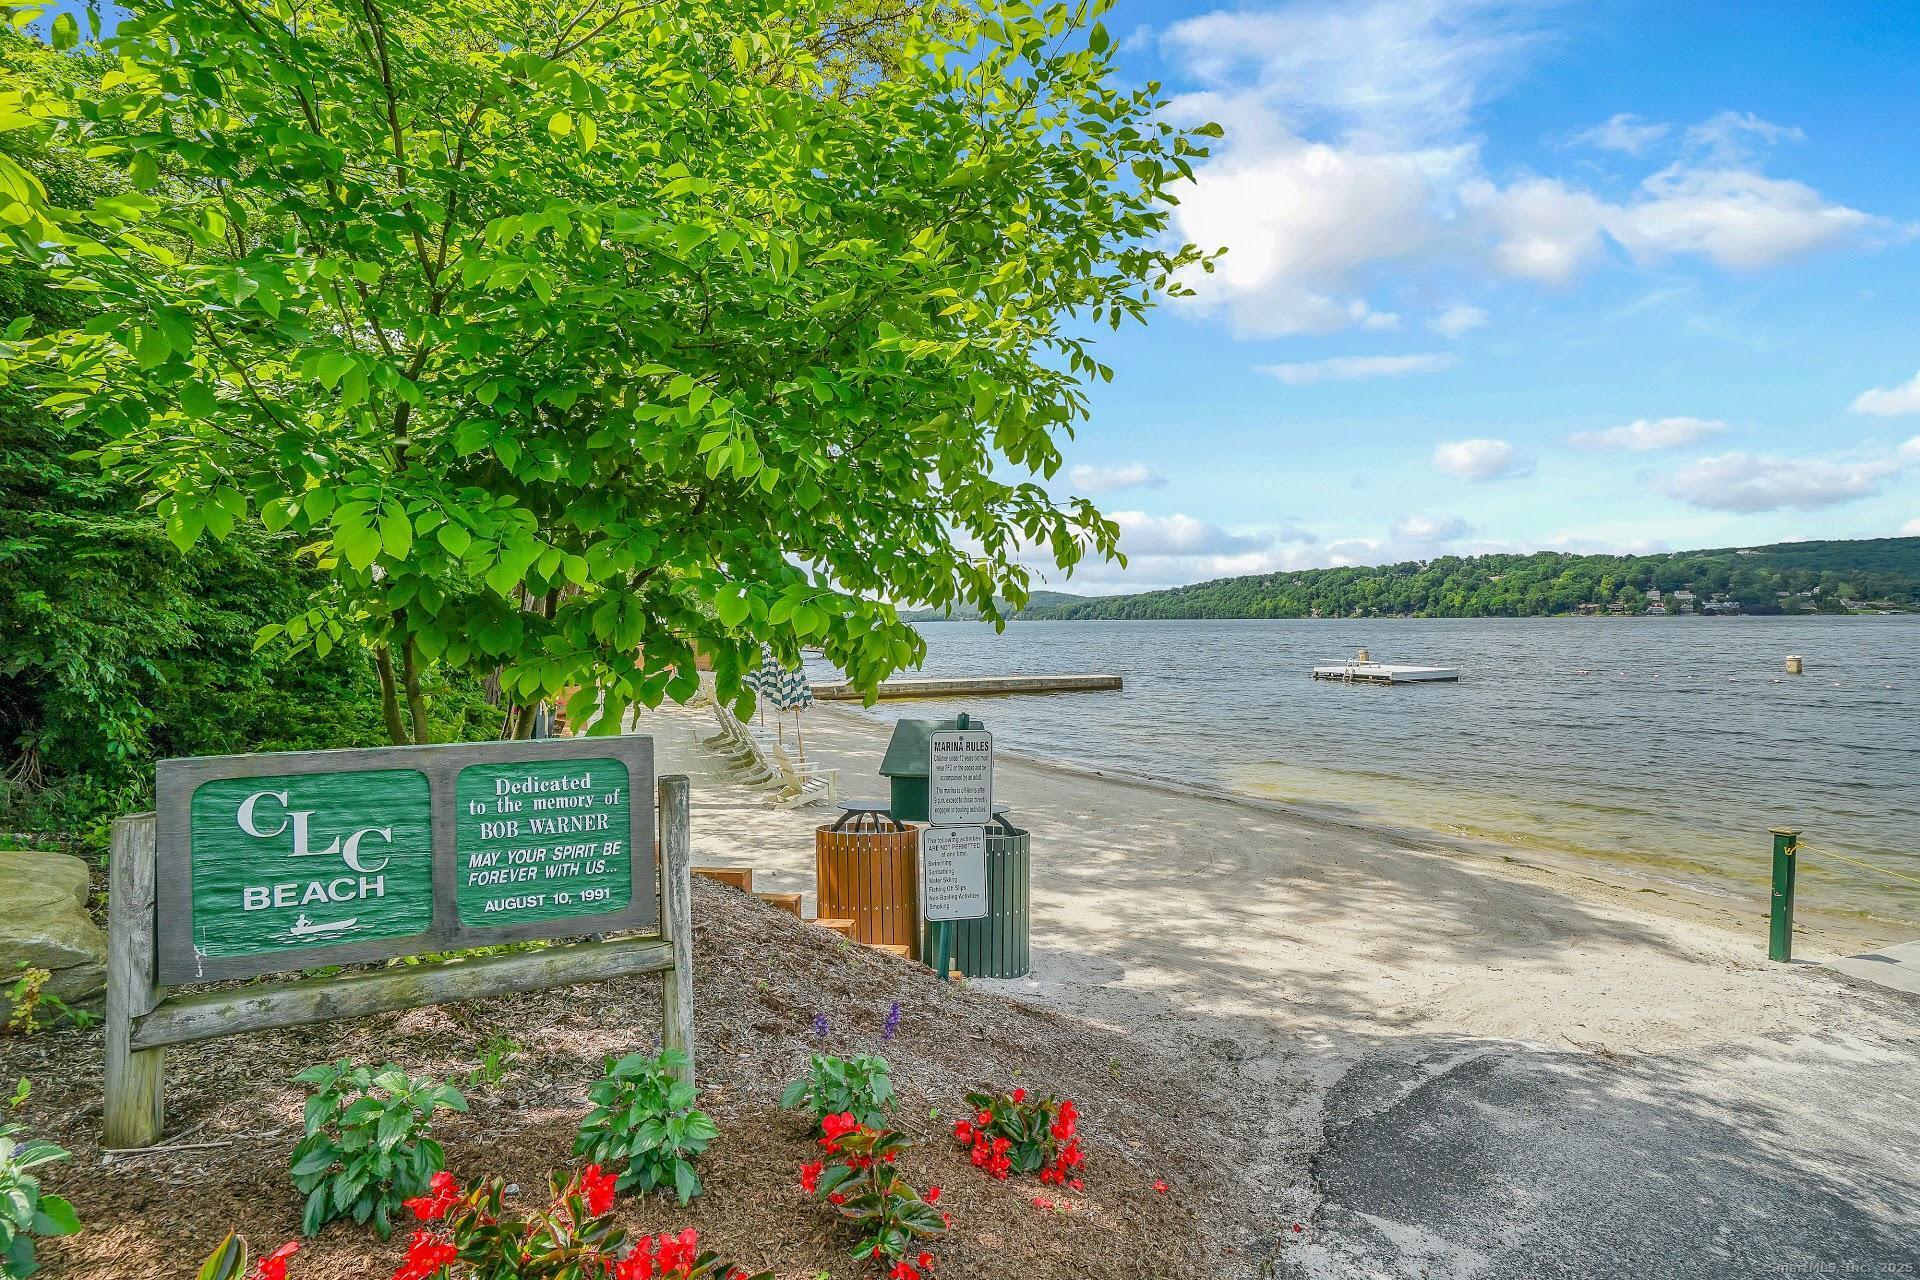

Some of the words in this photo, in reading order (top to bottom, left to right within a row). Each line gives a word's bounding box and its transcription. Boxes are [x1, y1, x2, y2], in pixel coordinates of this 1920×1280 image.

[934, 742, 964, 752] MARINA
[965, 742, 989, 752] RULES
[495, 772, 591, 796] Dedicated
[469, 799, 486, 815] to
[497, 796, 523, 813] the
[533, 794, 594, 811] memory
[604, 789, 620, 805] of
[237, 791, 391, 873] CLC
[480, 821, 519, 840] BOB
[529, 814, 609, 835] WARNER
[468, 852, 500, 869] MAY
[507, 848, 546, 865] YOUR
[552, 843, 598, 861] SPIRIT
[603, 841, 622, 856] BE
[951, 842, 981, 850] PERMITTED
[468, 866, 537, 887] FOREVER
[545, 862, 580, 879] WITH
[928, 868, 955, 876] Sunbathing
[243, 874, 385, 911] BEACH
[484, 894, 545, 912] AUGUST
[553, 892, 572, 905] 10,
[579, 888, 610, 902] 1991
[954, 884, 967, 892] Slips
